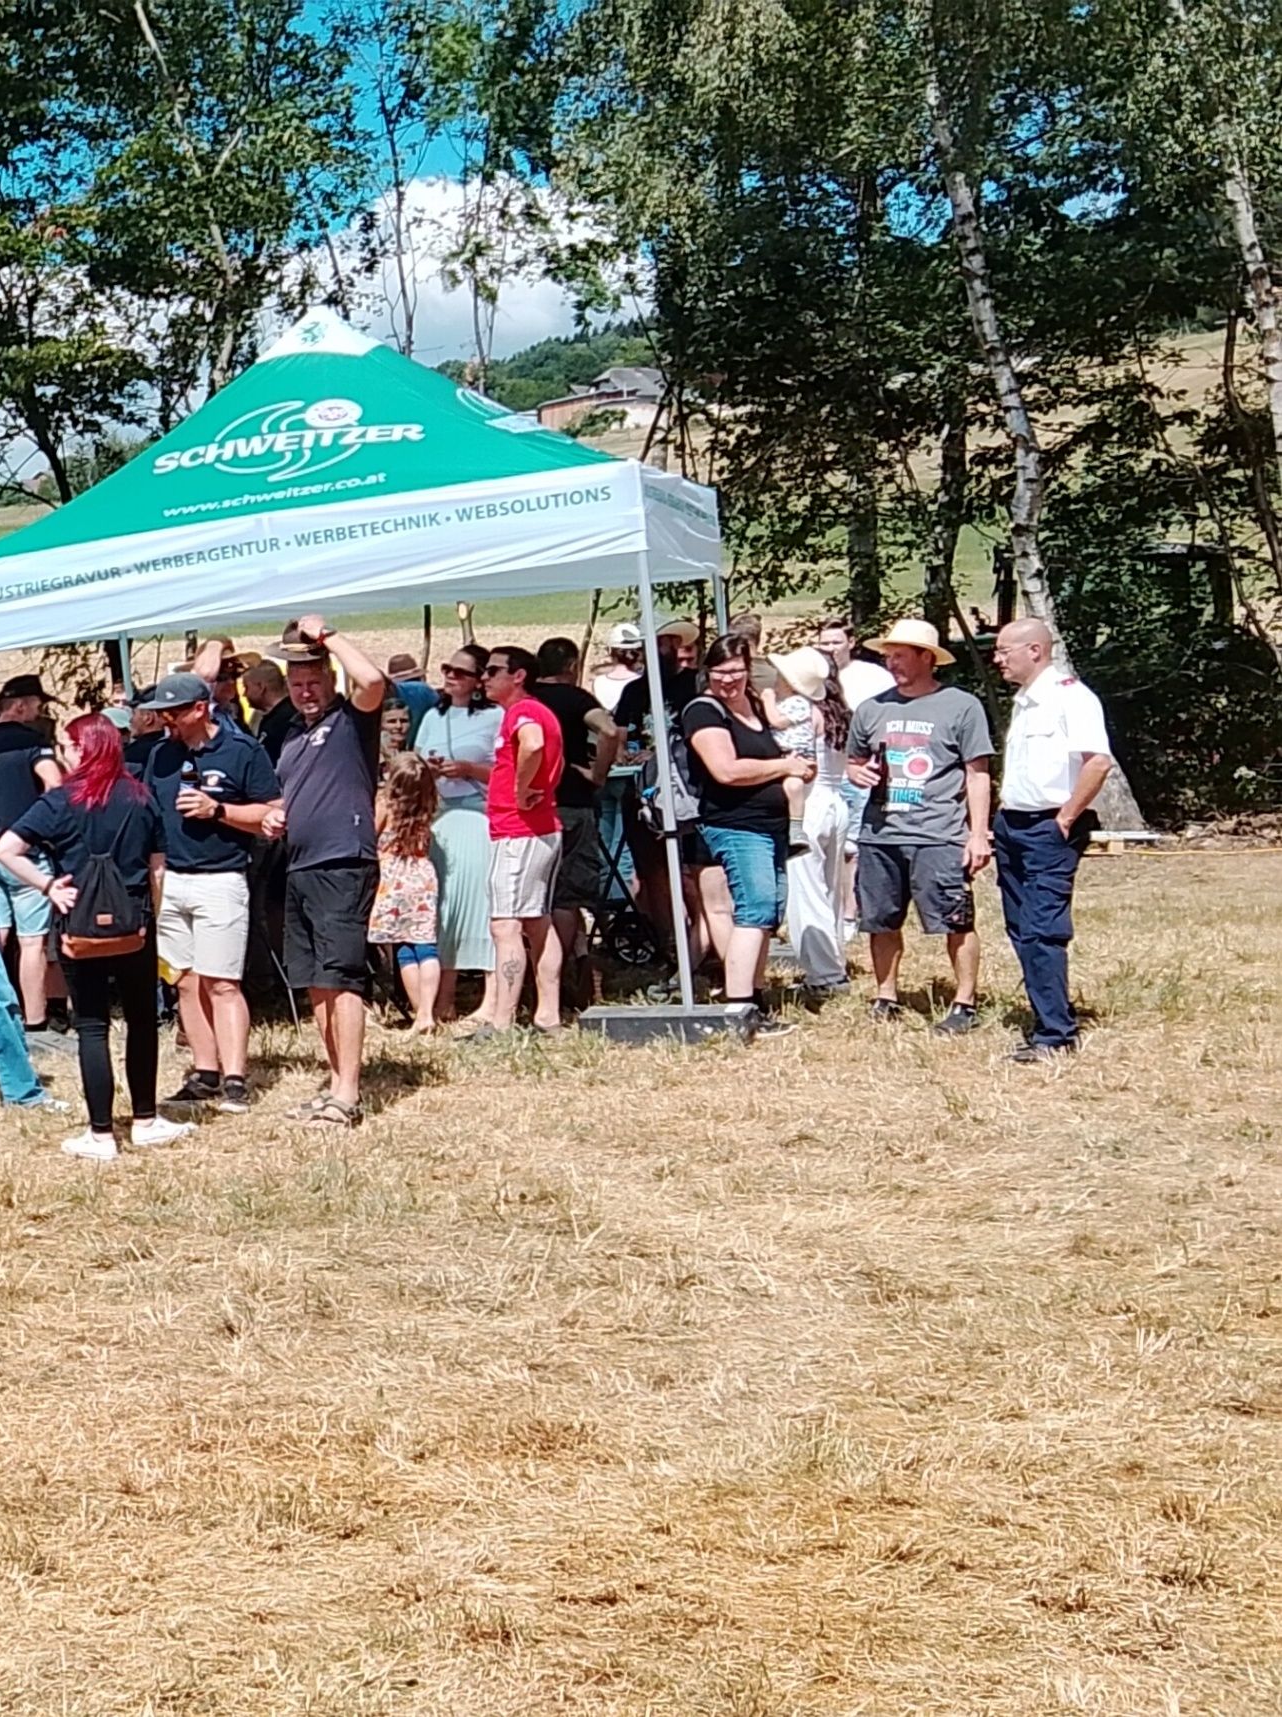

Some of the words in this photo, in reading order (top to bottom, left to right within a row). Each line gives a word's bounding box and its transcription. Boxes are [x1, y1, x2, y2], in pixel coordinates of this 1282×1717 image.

[152, 423, 426, 474] SCHWEITZER
[162, 472, 387, 517] www.schweitzer.co.at
[133, 538, 280, 575] WERBEAGENTUR
[294, 512, 441, 547] WERBETECHNIK
[455, 486, 612, 522] WEBSOLUTIONS
